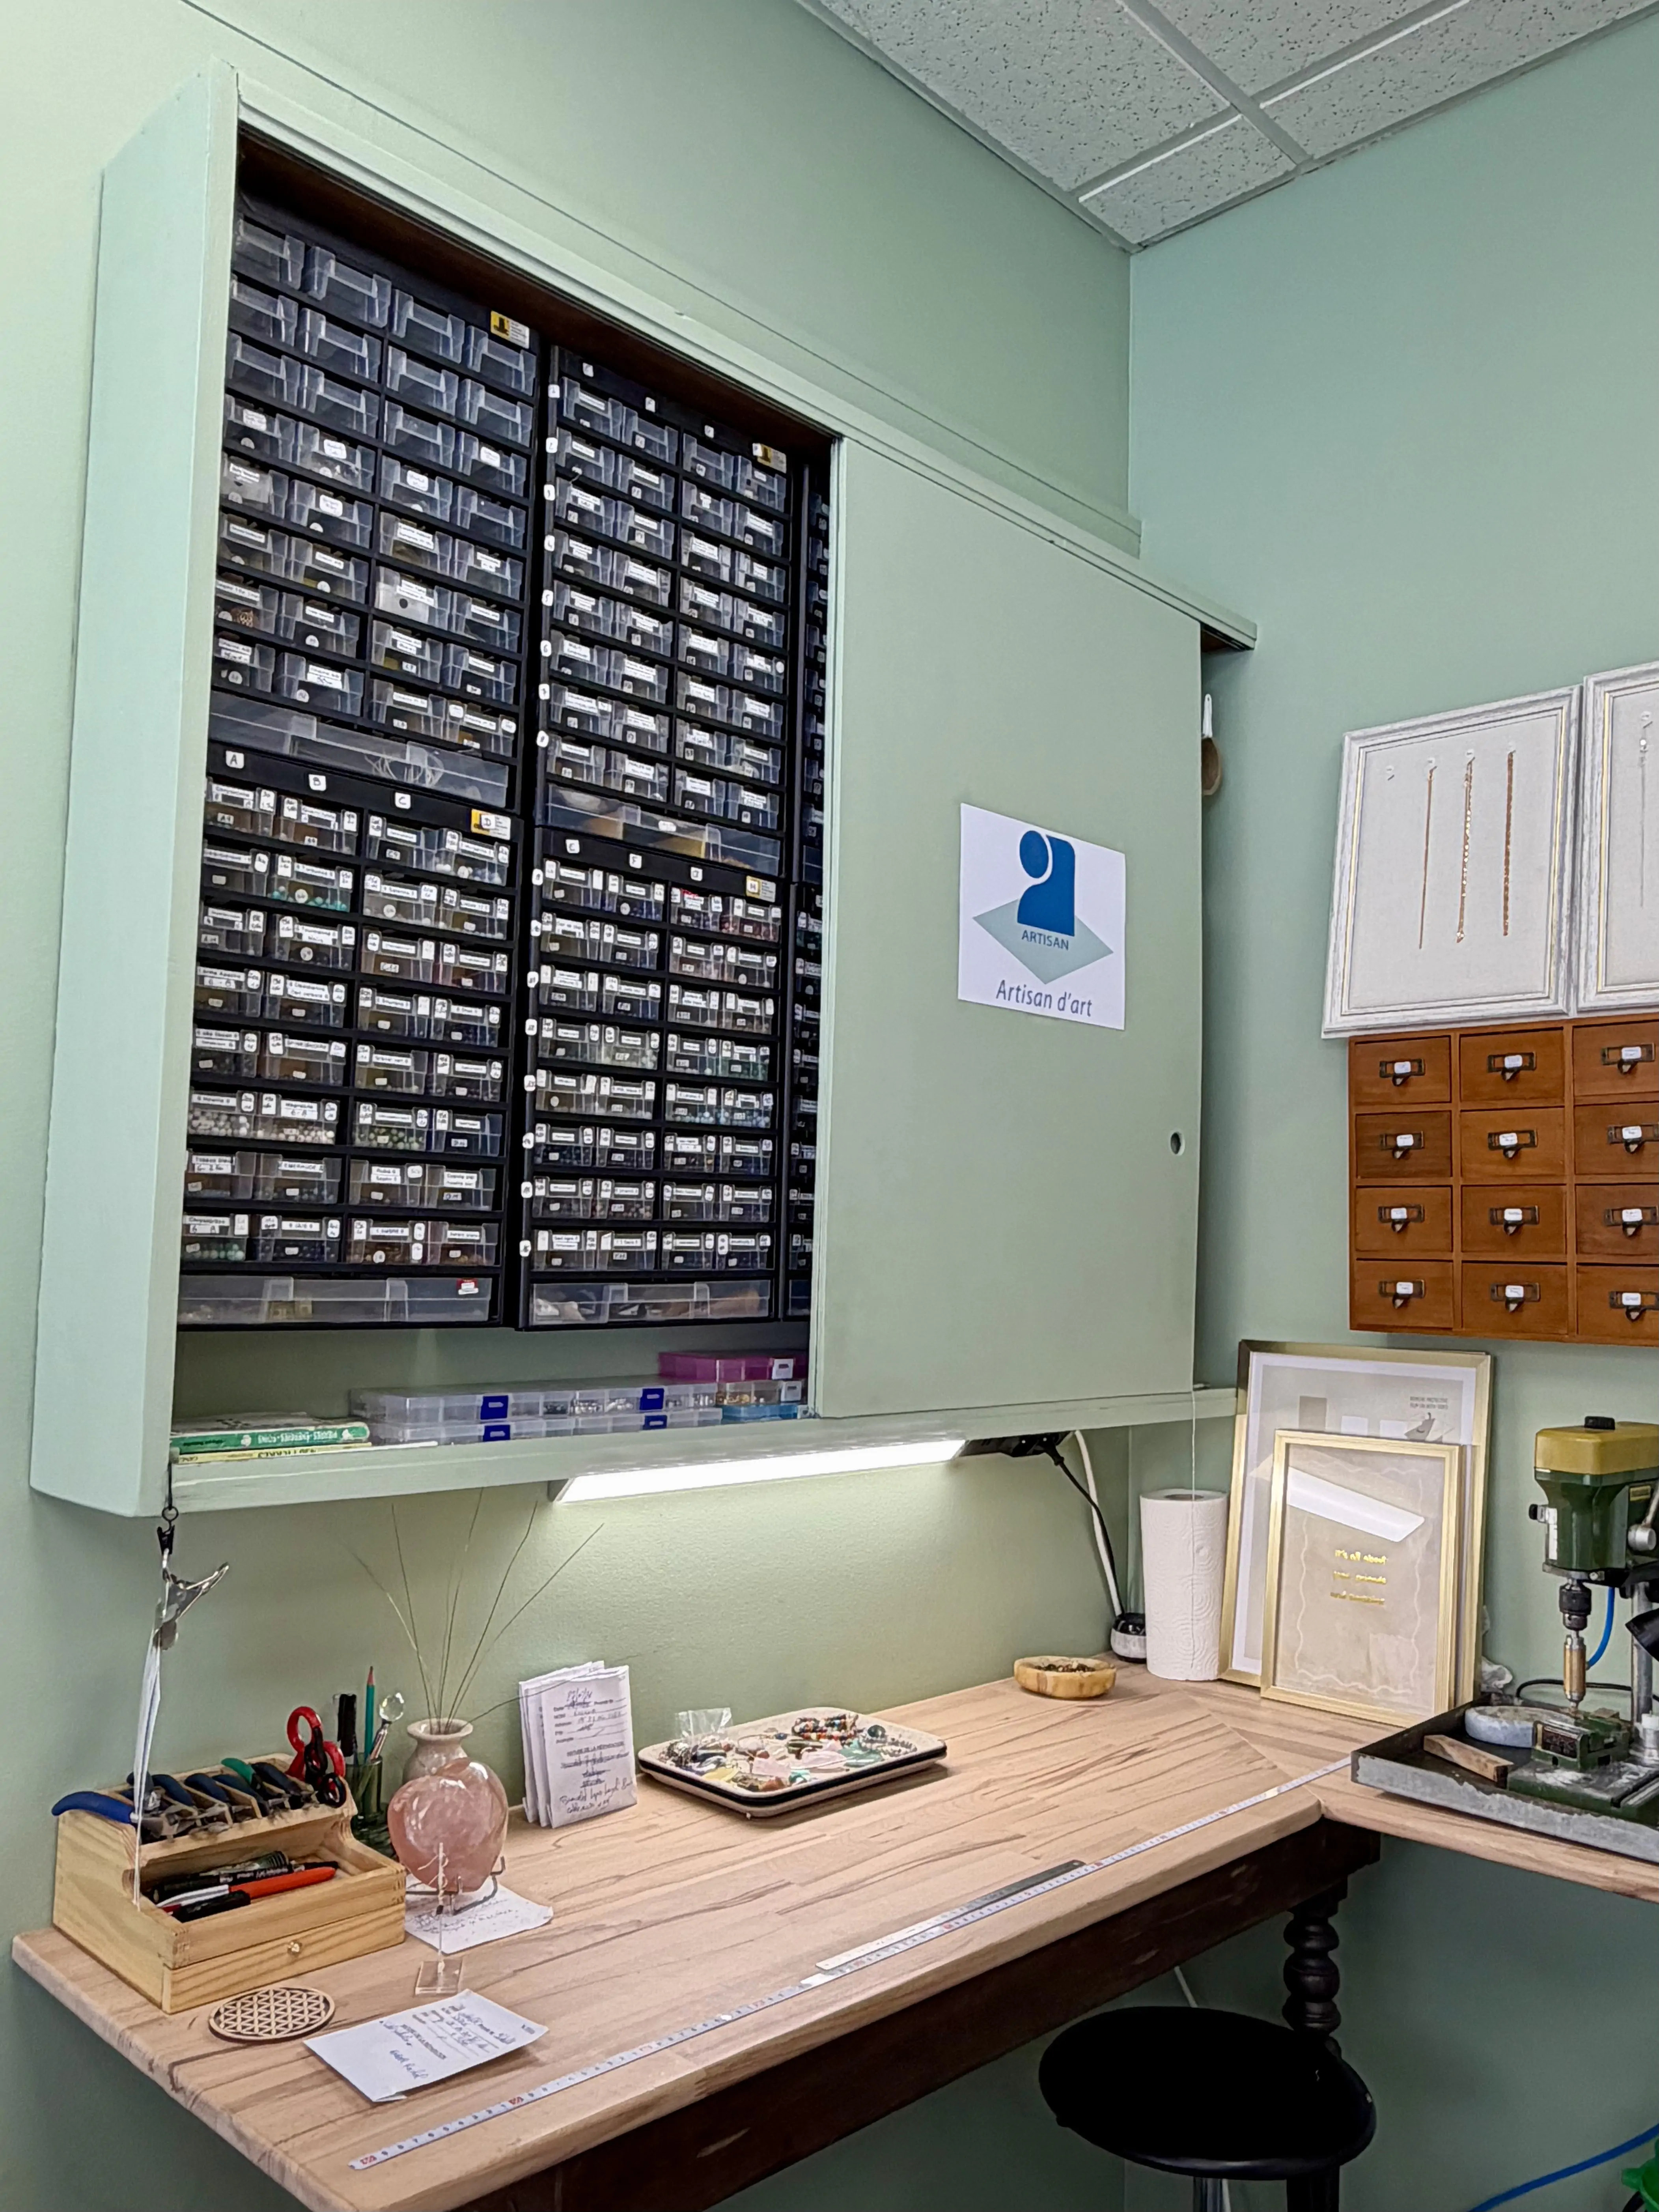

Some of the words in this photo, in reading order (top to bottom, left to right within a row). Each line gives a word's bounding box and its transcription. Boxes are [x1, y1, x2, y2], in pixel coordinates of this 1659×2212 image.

[230, 754, 237, 765] A
[312, 777, 321, 786] B
[399, 796, 407, 805] C
[1021, 930, 1069, 951] ARTISAN
[996, 980, 1052, 1009] Artisan
[1058, 991, 1093, 1017] d'art
[1349, 1551, 1361, 1561] all
